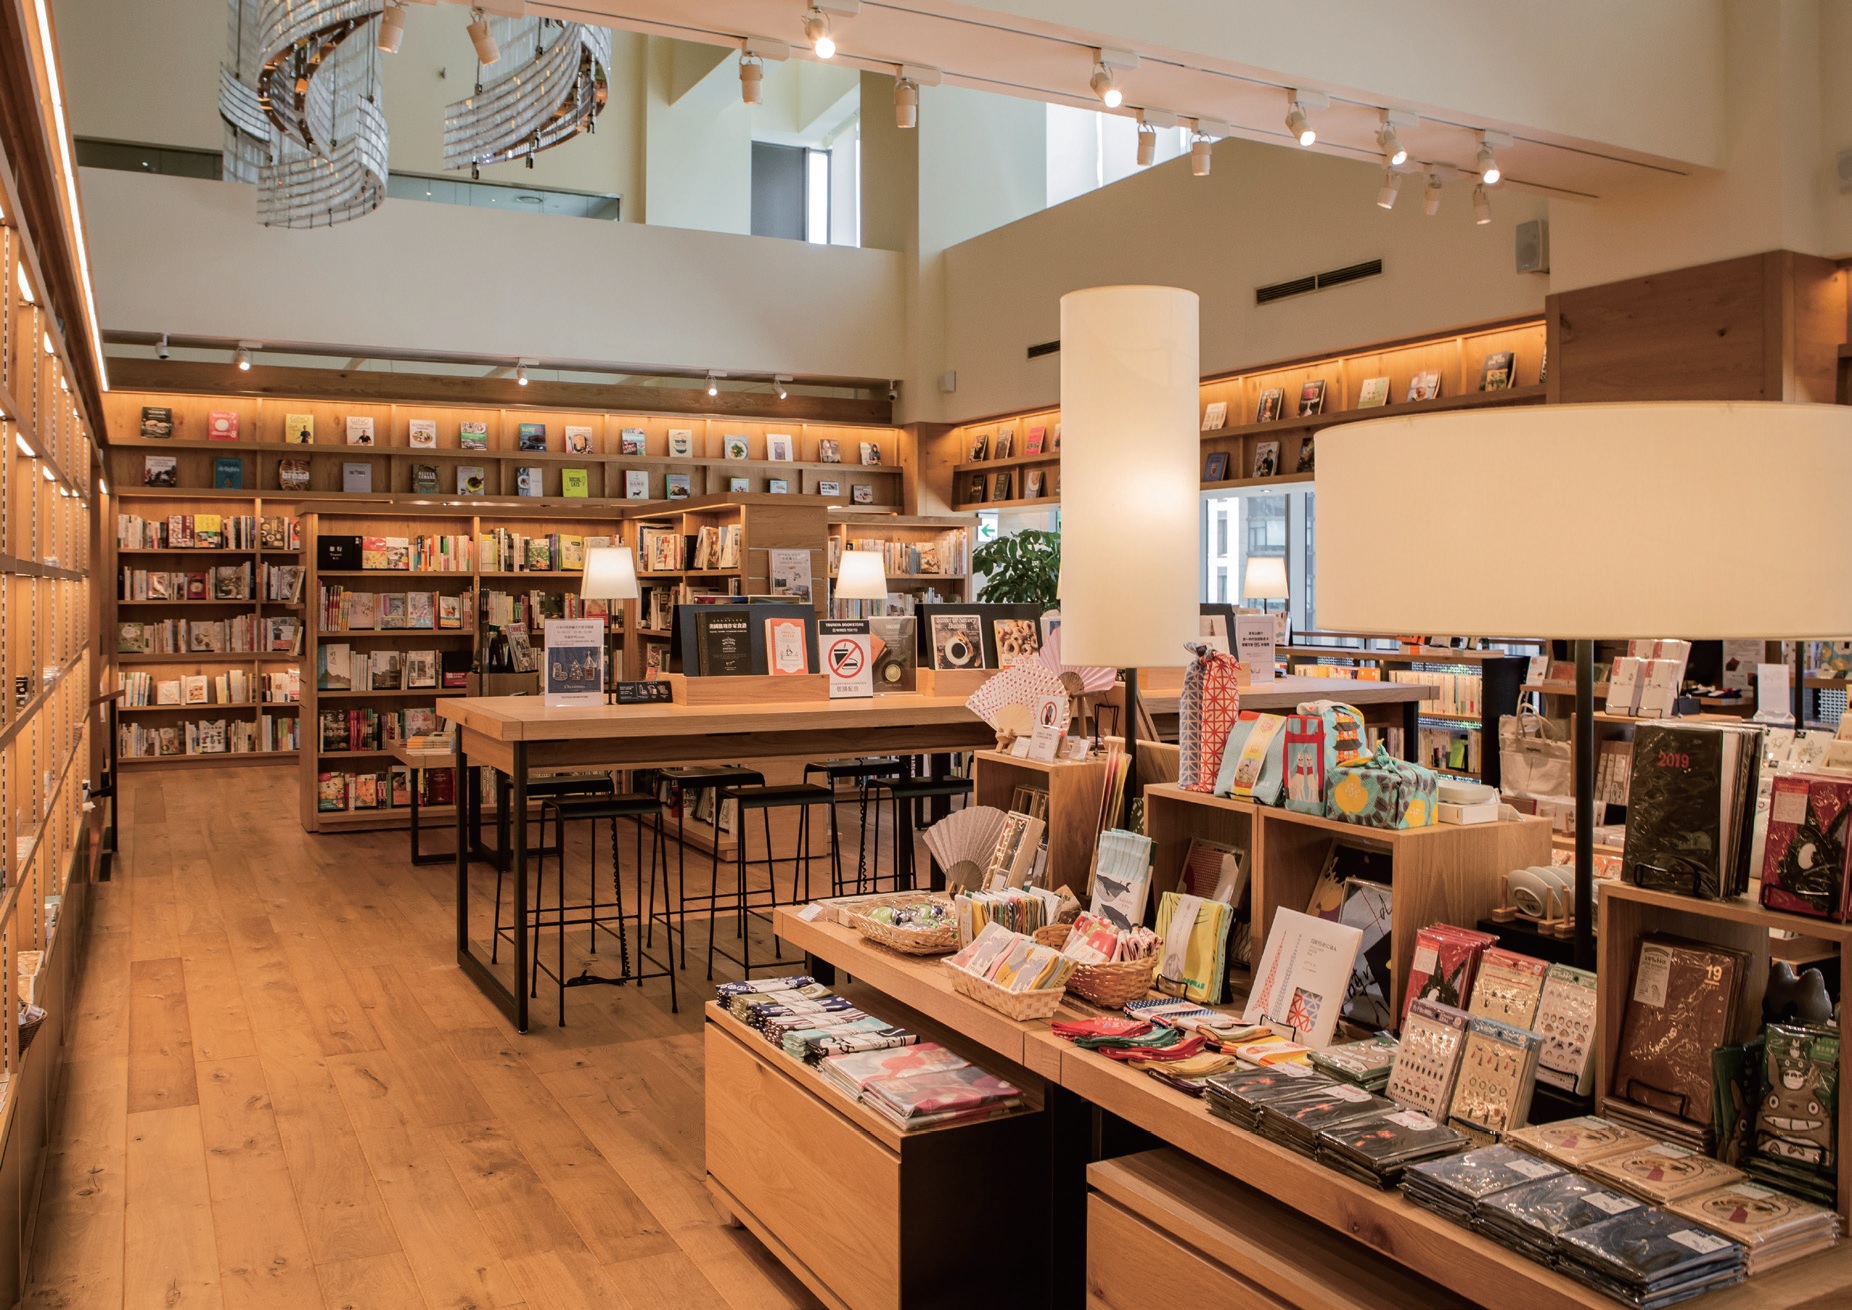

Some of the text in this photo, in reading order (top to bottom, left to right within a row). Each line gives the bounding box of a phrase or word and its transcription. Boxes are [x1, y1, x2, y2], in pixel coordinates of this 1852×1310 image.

[282, 471, 310, 480] bread
[1657, 752, 1690, 769] 2019
[1706, 964, 1723, 981] 19
